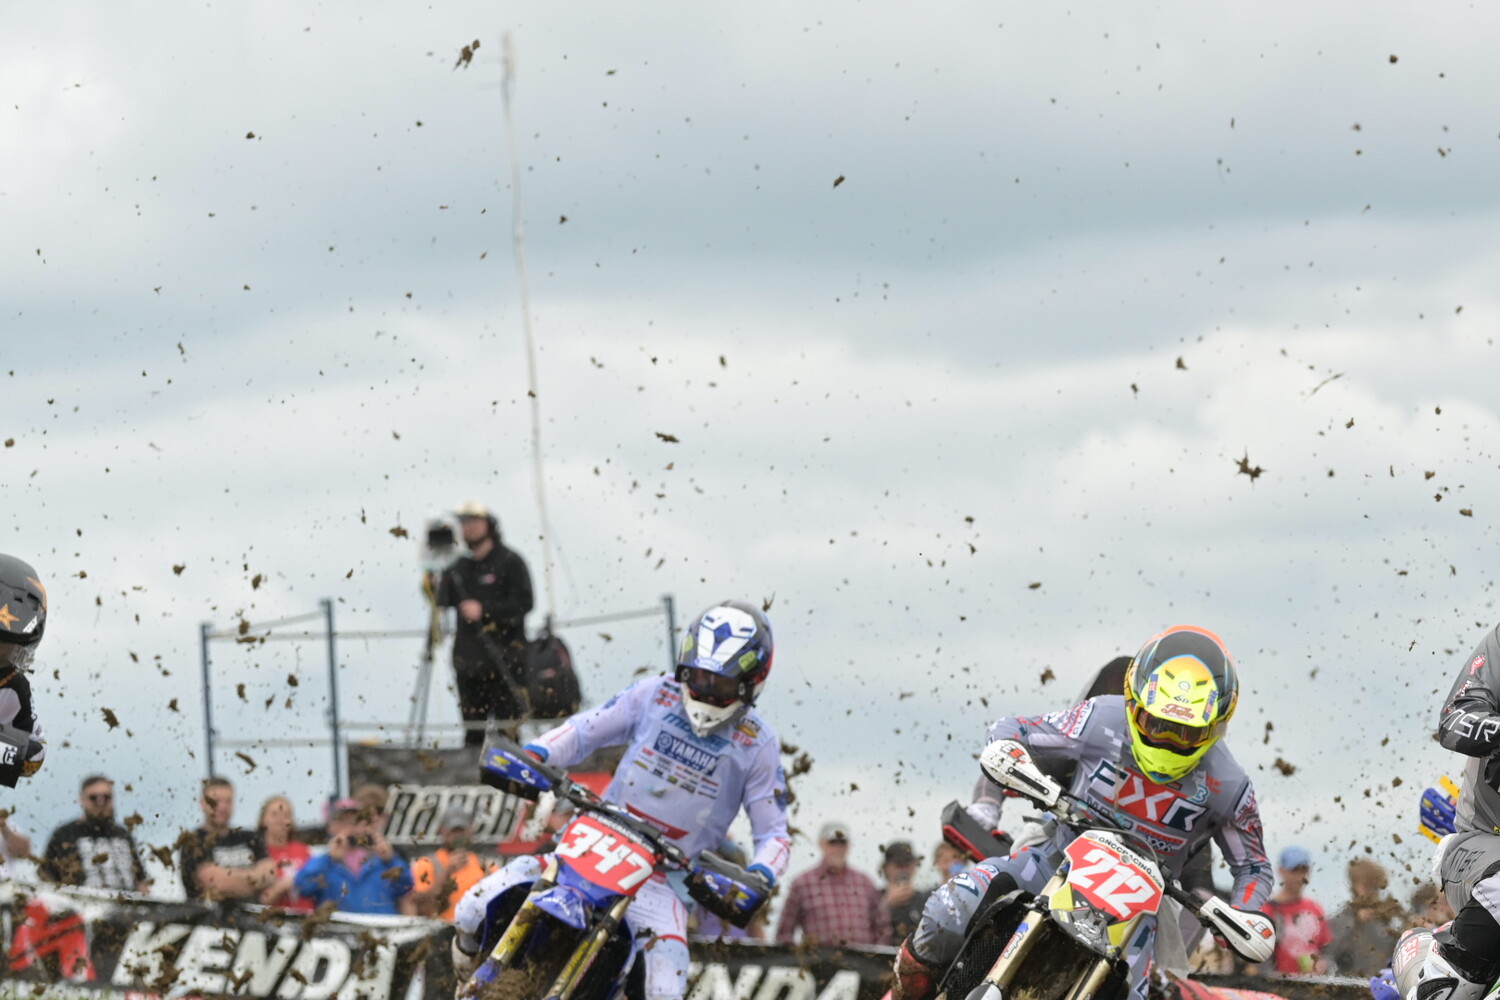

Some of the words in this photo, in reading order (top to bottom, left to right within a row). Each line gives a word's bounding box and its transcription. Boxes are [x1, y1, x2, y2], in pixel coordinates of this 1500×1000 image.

[671, 739, 718, 770] YAMAHA
[555, 822, 653, 890] 347
[1067, 848, 1156, 918] 212
